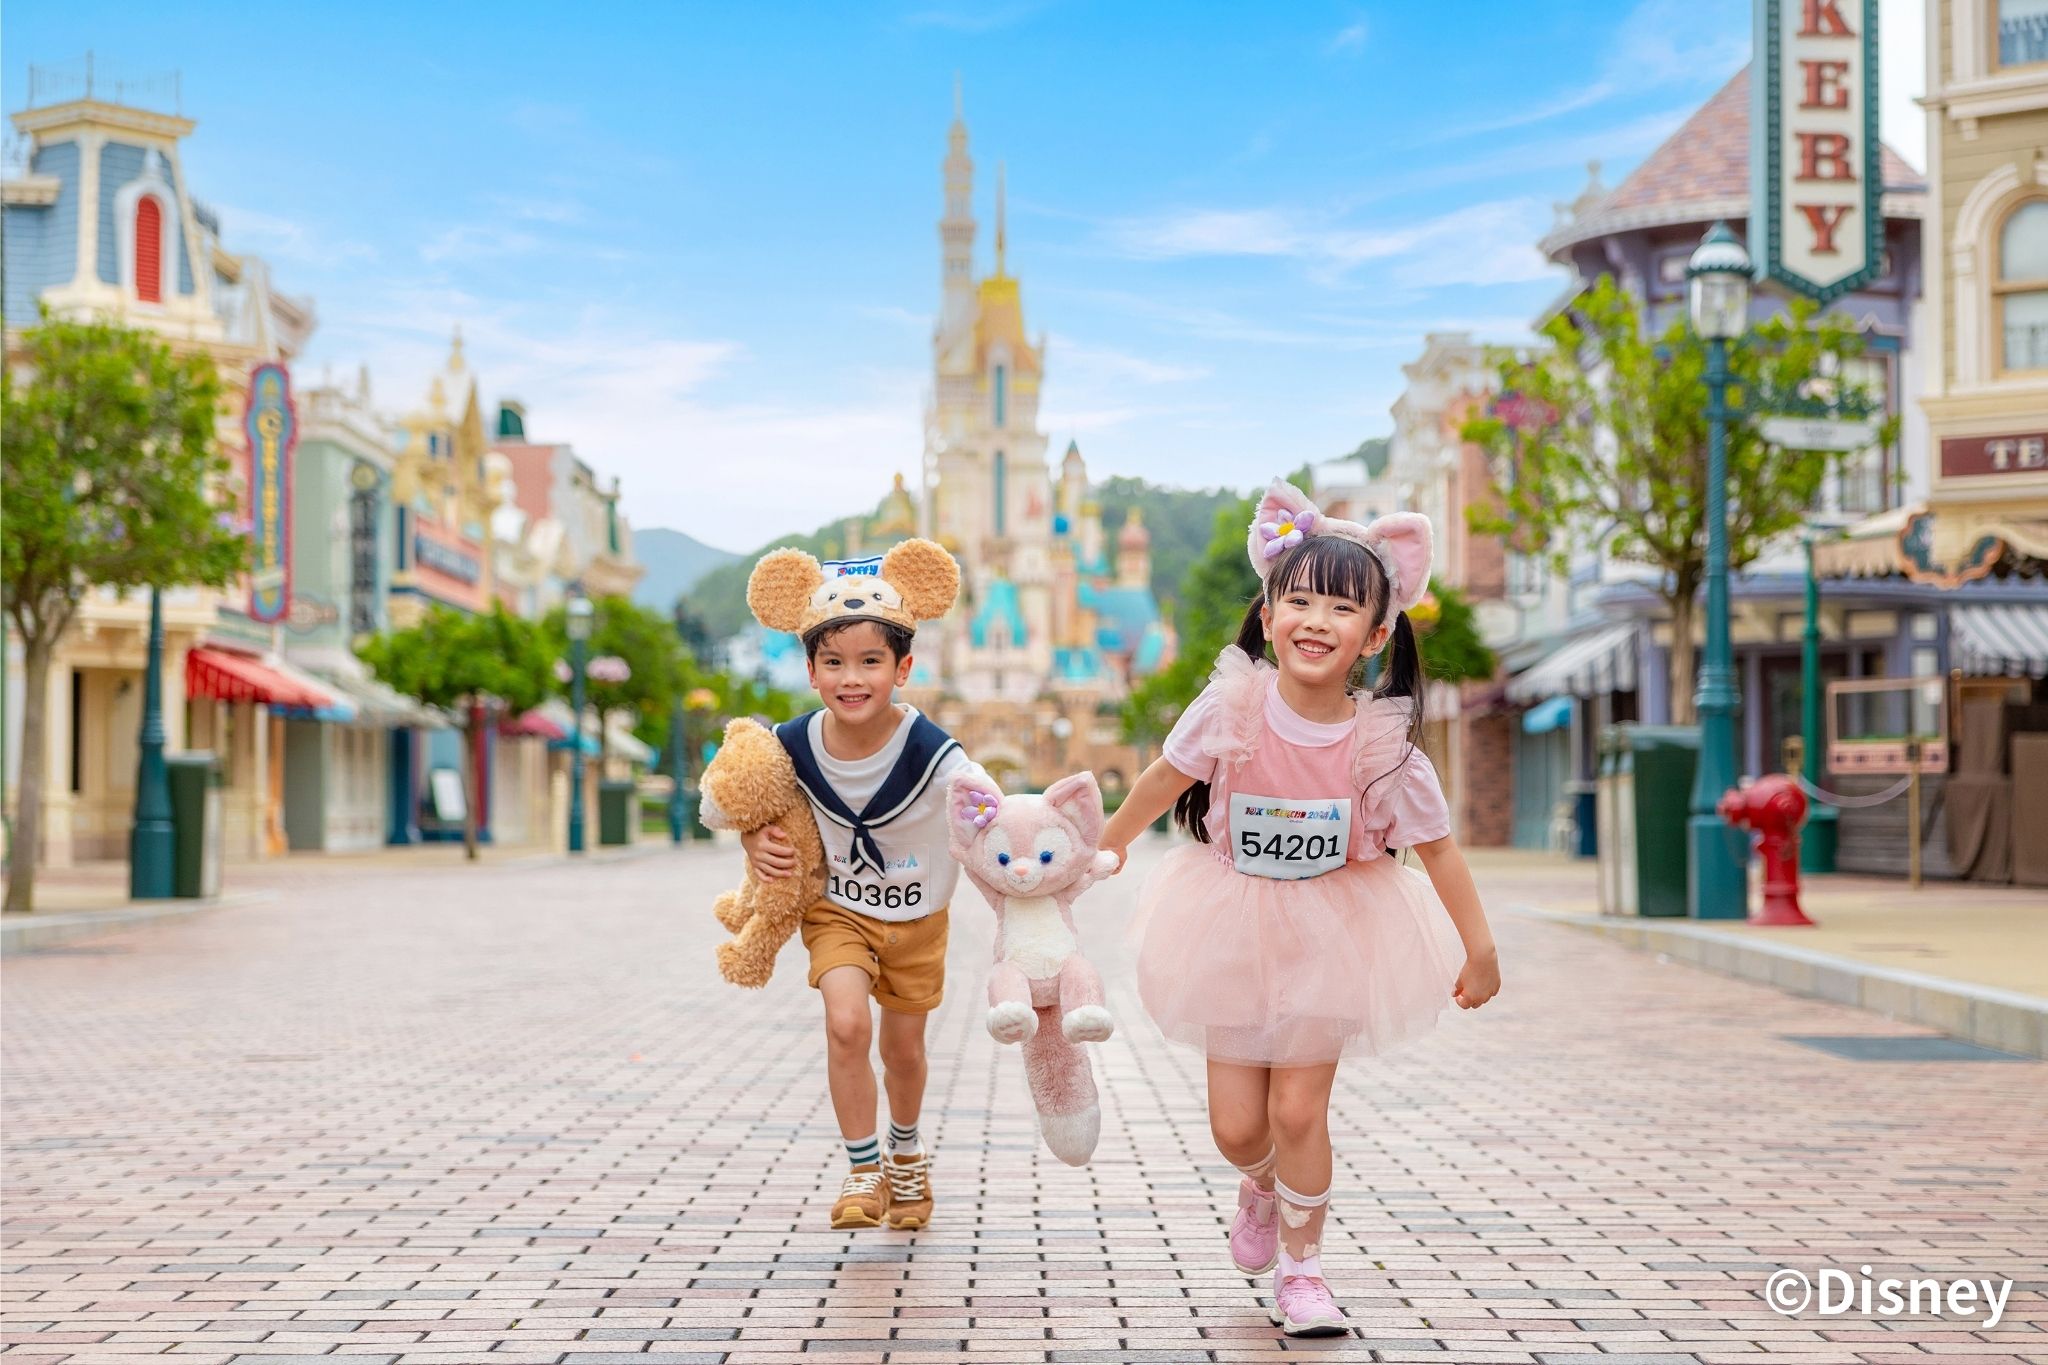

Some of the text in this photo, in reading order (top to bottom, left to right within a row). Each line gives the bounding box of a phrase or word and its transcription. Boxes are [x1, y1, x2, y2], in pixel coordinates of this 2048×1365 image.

[1795, 0, 1856, 255] KERY
[1983, 437, 2048, 471] TE
[837, 565, 879, 578] Duffy
[1266, 808, 1307, 819] WEEKEND
[1241, 830, 1341, 861] 54201
[830, 875, 922, 909] 10366
